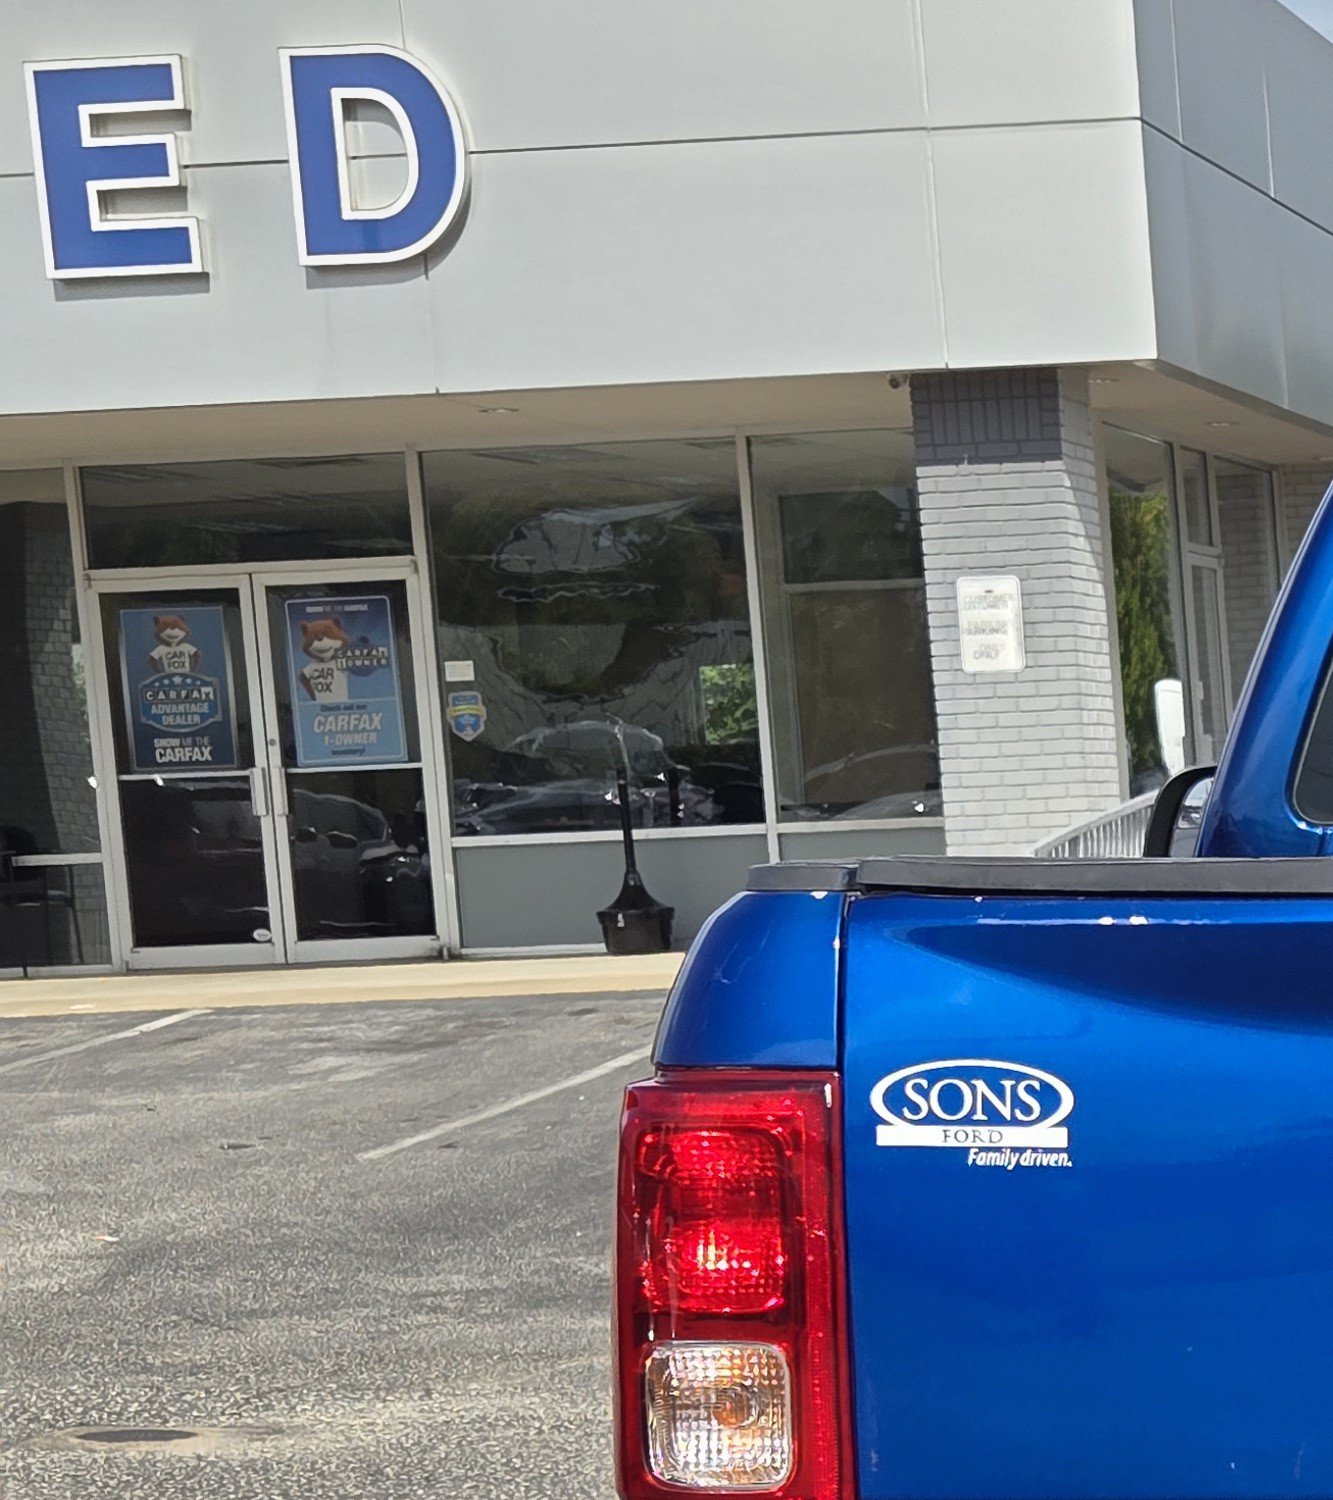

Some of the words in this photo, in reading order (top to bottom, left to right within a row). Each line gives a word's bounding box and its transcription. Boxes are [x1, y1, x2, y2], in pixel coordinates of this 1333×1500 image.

[165, 651, 186, 660] CAR
[167, 660, 187, 670] FOX
[151, 703, 210, 715] ADVANTAGE
[162, 715, 200, 726] DEALER
[314, 713, 383, 733] CARFAX
[324, 732, 378, 746] 1-OWNER
[155, 746, 213, 764] CARFAX
[902, 1078, 1041, 1122] SONS
[942, 1129, 1003, 1144] FORD
[968, 1148, 1020, 1170] Family
[1020, 1148, 1073, 1168] driven.
